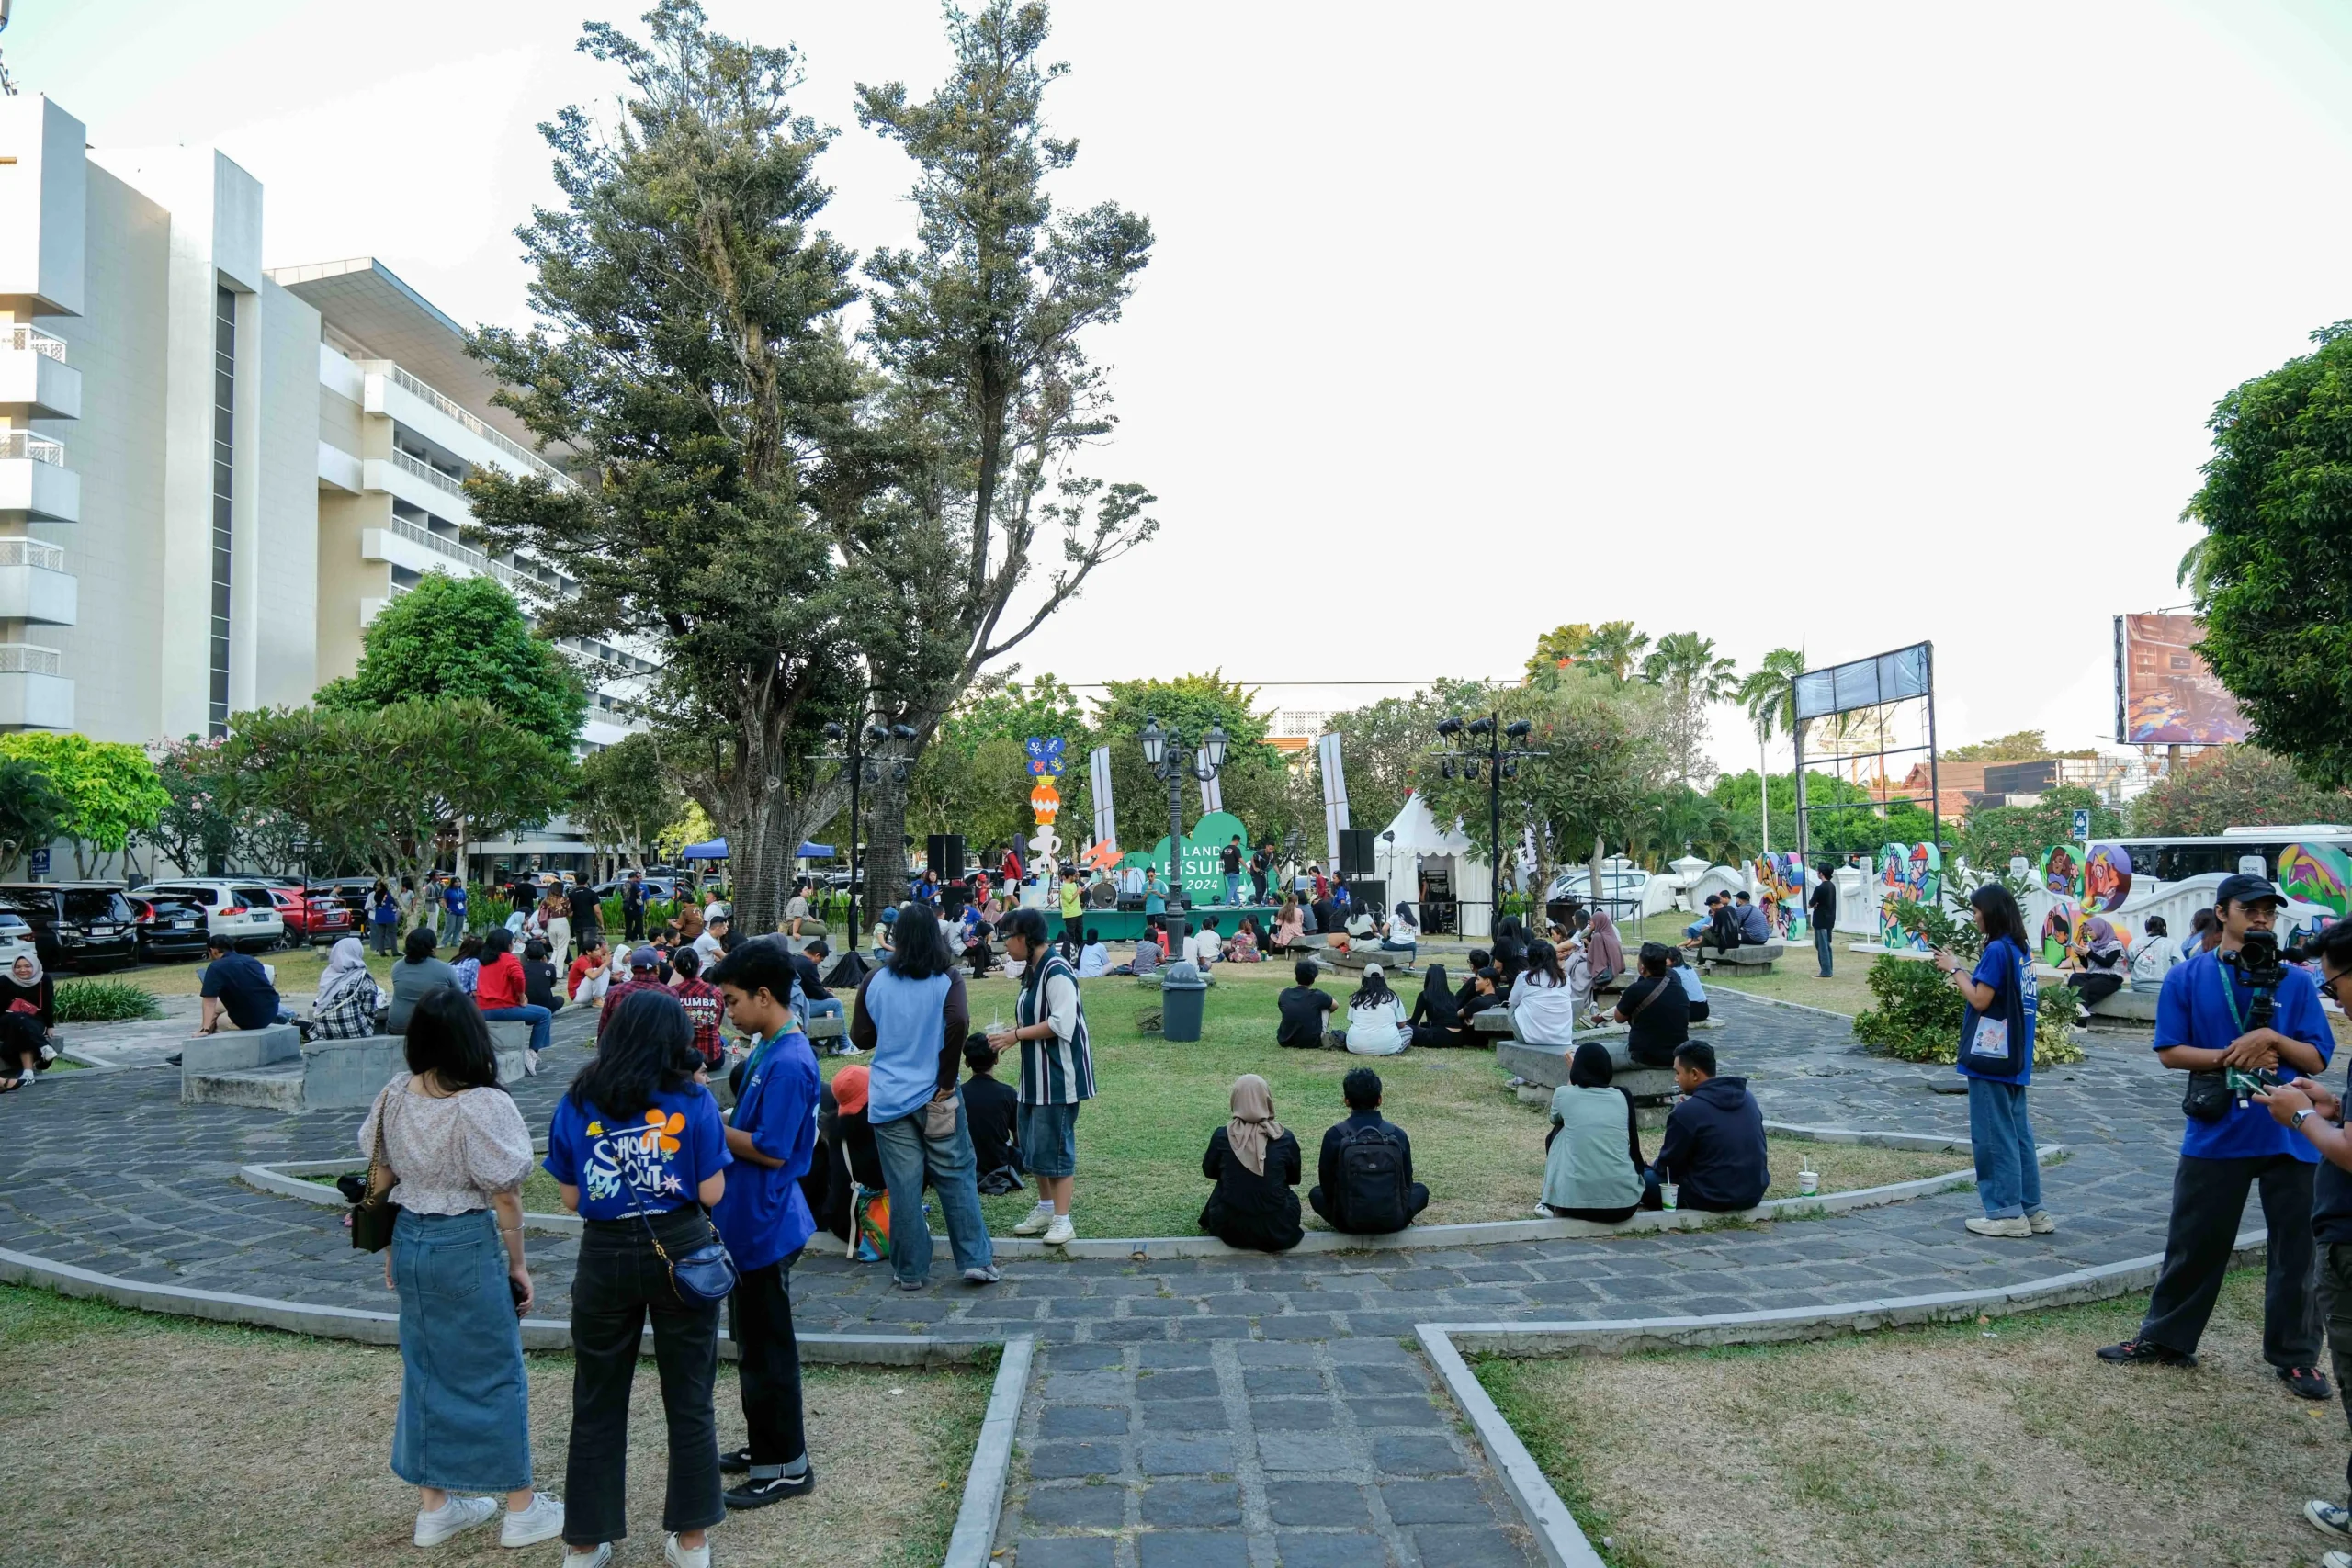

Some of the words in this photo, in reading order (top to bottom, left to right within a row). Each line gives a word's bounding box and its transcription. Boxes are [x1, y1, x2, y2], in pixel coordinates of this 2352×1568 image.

[1182, 846, 1221, 856] LAND
[1186, 879, 1218, 890] 2024
[680, 998, 717, 1007] ZUMBA
[592, 1131, 662, 1177] SHOUT
[625, 1160, 662, 1191] OUT
